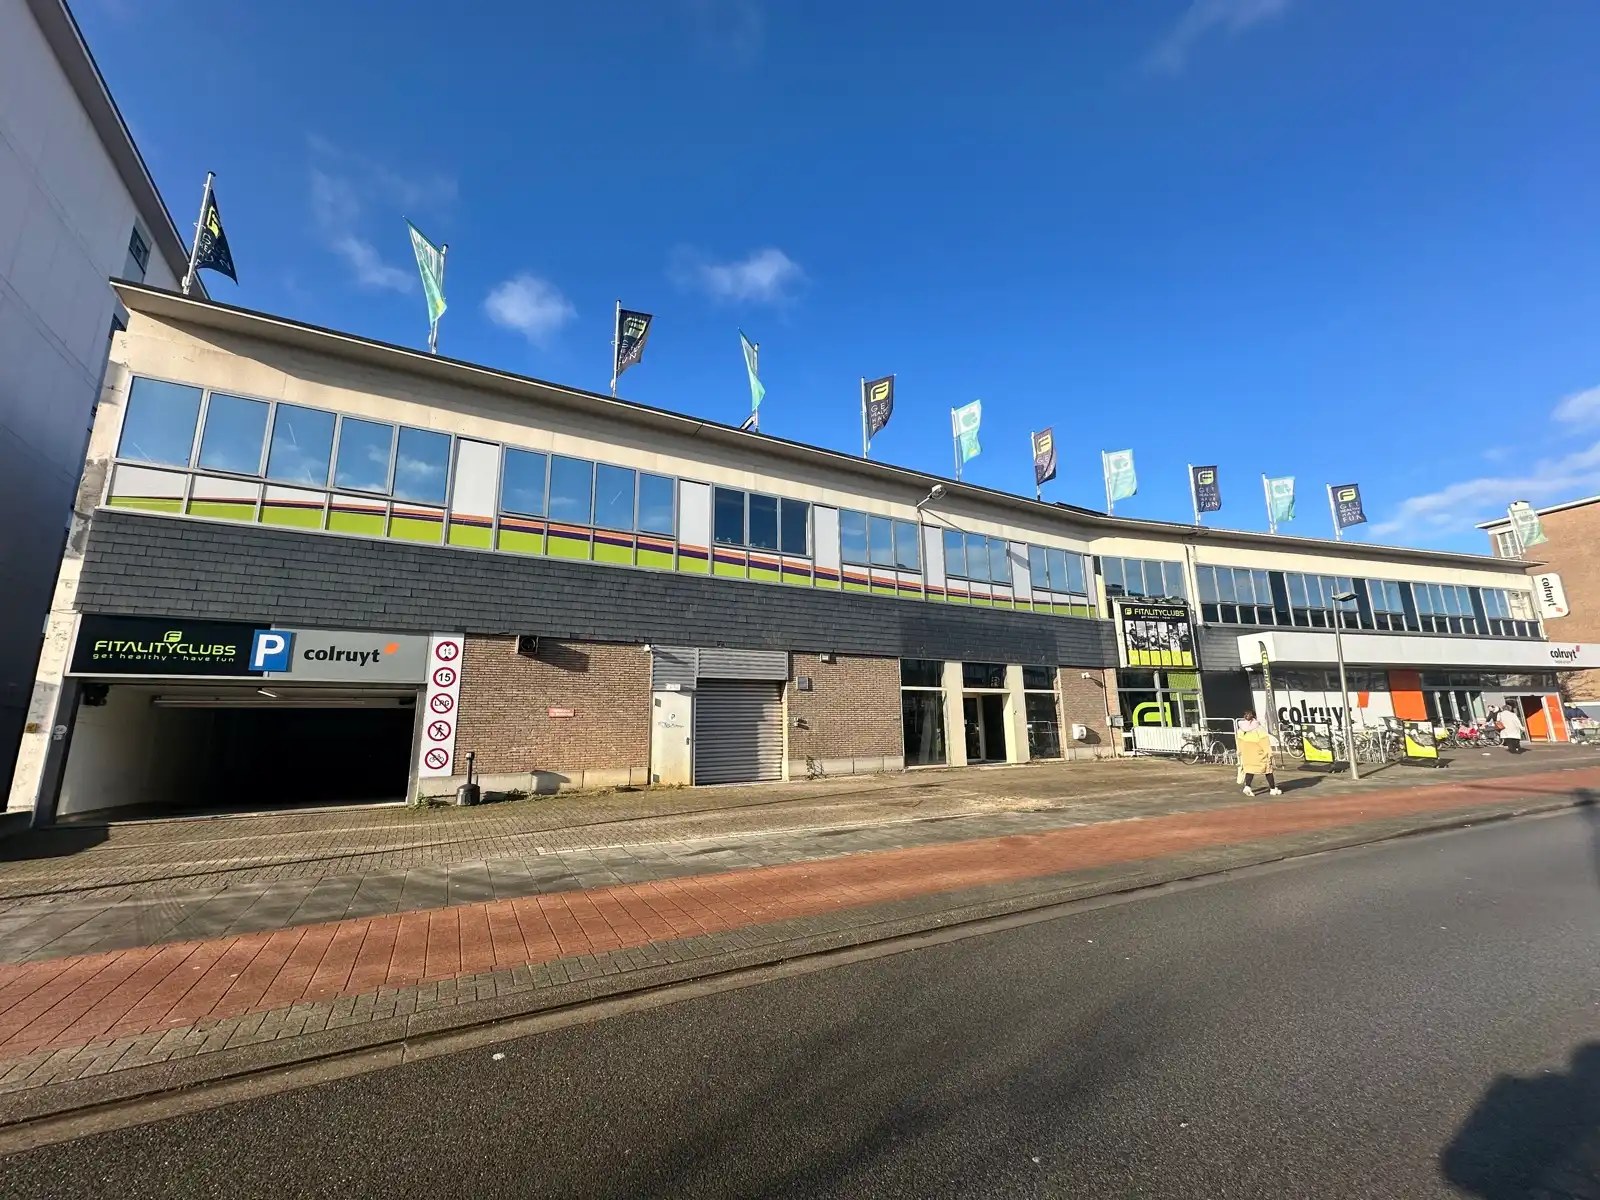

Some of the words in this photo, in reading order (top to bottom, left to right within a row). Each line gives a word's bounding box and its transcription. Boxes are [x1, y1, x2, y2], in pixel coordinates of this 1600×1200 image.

[1541, 577, 1557, 607] colruyt
[94, 640, 236, 656] FITALITYCLUBS
[254, 634, 285, 667] P
[1550, 648, 1577, 662] colruyt
[120, 653, 167, 662] healthy
[303, 646, 380, 667] colruyt
[439, 672, 451, 682] 15
